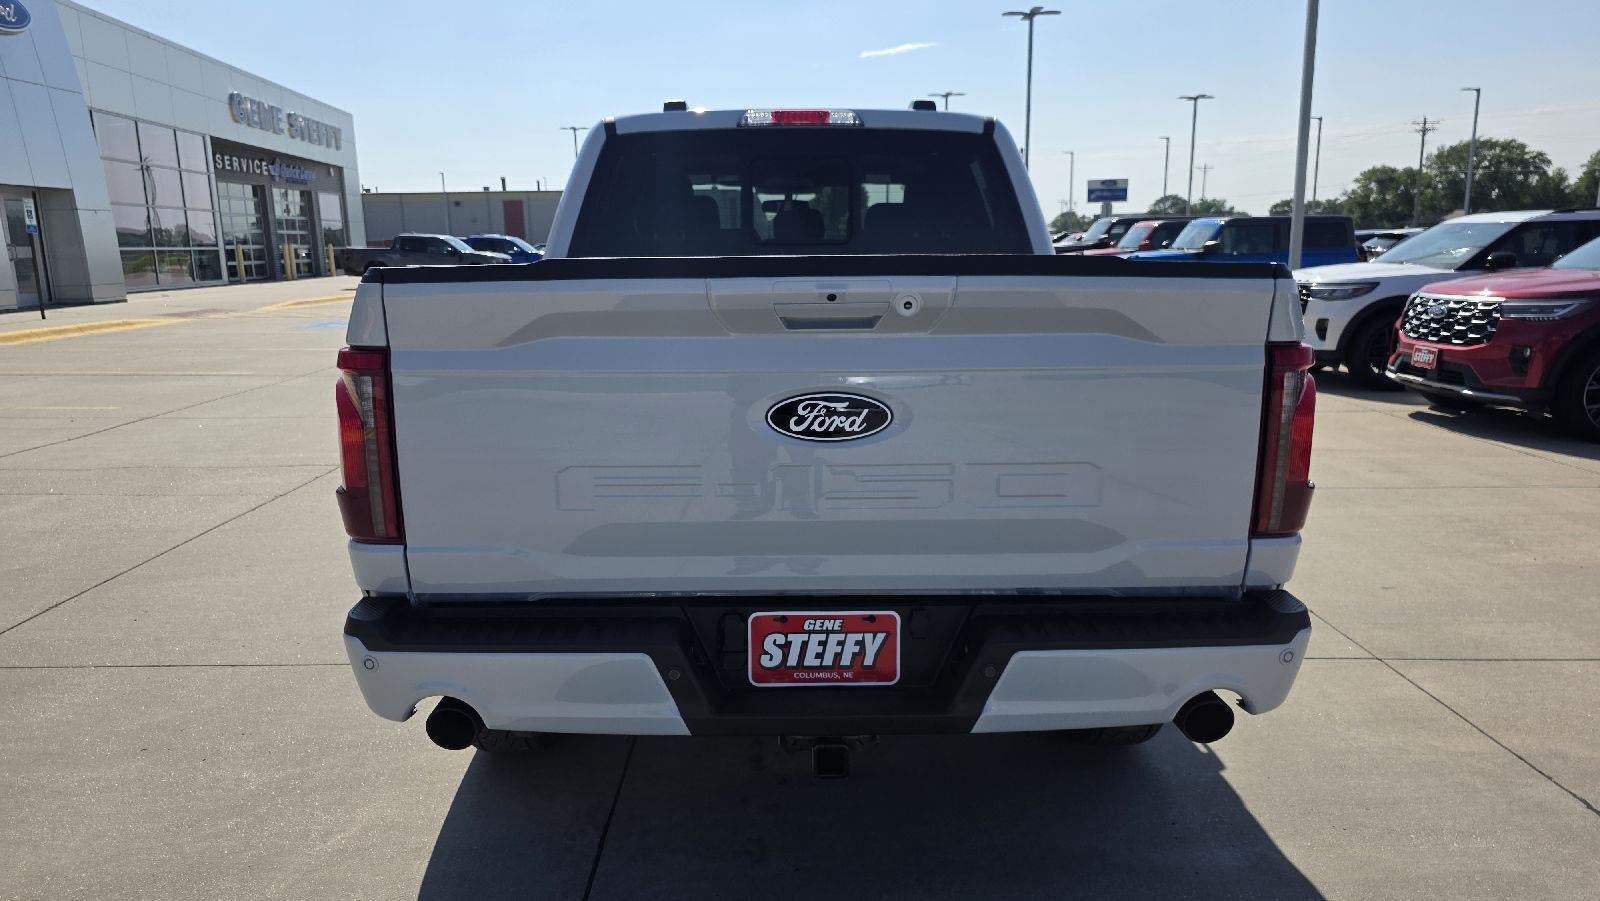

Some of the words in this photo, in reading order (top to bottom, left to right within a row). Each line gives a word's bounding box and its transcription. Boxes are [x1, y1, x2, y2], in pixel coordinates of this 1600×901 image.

[215, 154, 269, 176] SERVICE
[789, 400, 869, 432] Ford
[556, 462, 1103, 512] F-150
[803, 619, 843, 631] GENE
[760, 632, 887, 668] STEFFY
[793, 671, 841, 680] COLUMBUS,
[843, 671, 854, 679] NE
